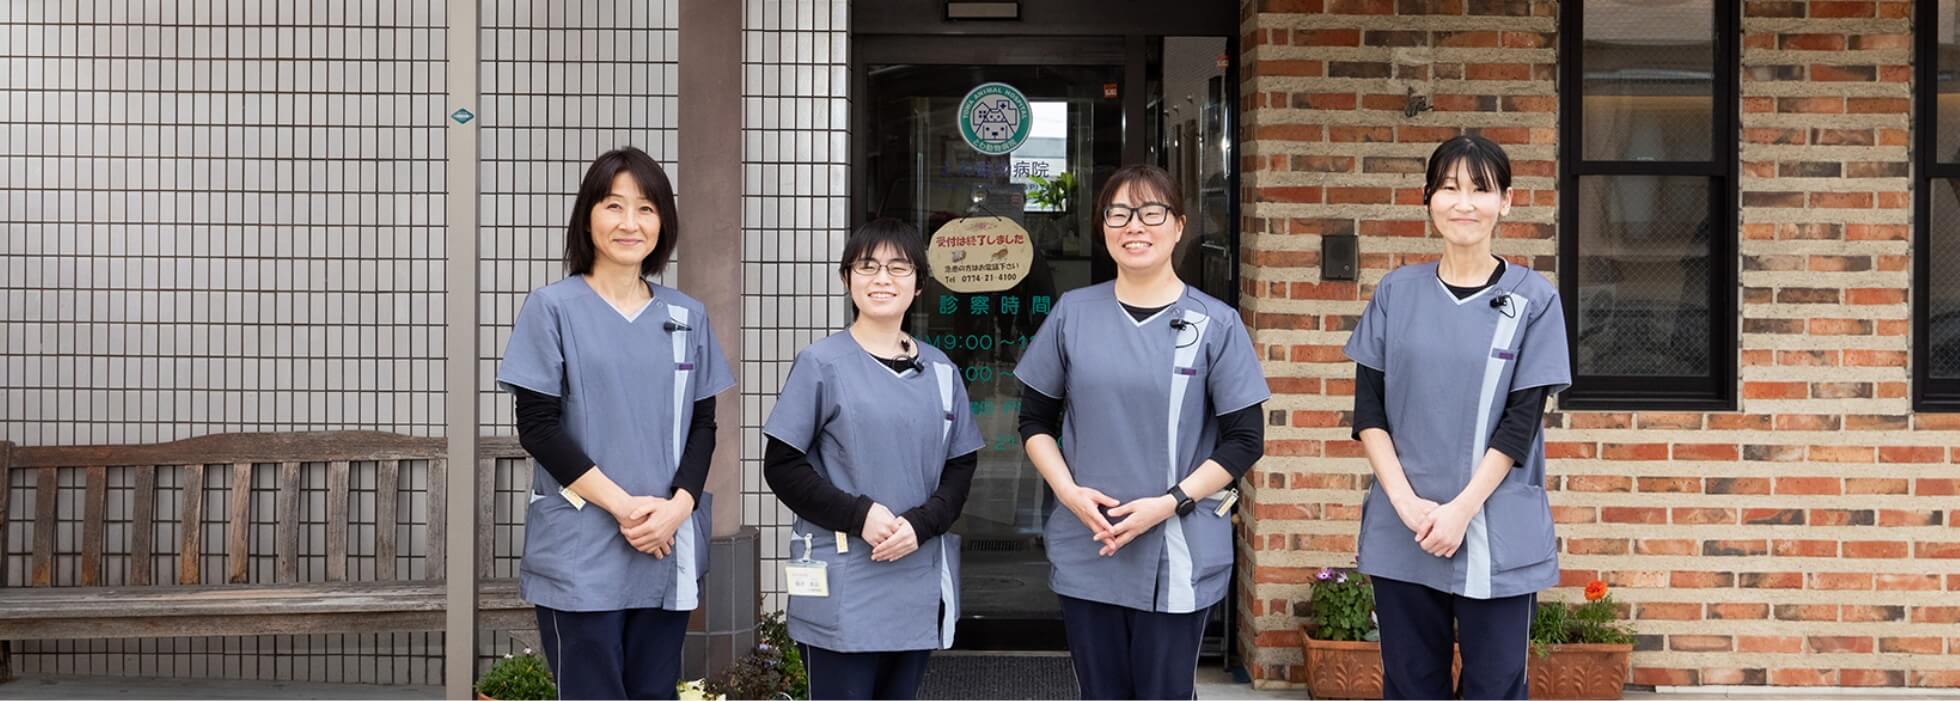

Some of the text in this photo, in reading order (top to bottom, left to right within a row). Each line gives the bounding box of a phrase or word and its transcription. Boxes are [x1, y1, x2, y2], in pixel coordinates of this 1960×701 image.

[974, 87, 1003, 100] ANIMAL
[1004, 89, 1028, 120] HOSPITAL
[935, 233, 1025, 249] 受付は終了しました
[938, 294, 1052, 316] 診察時間
